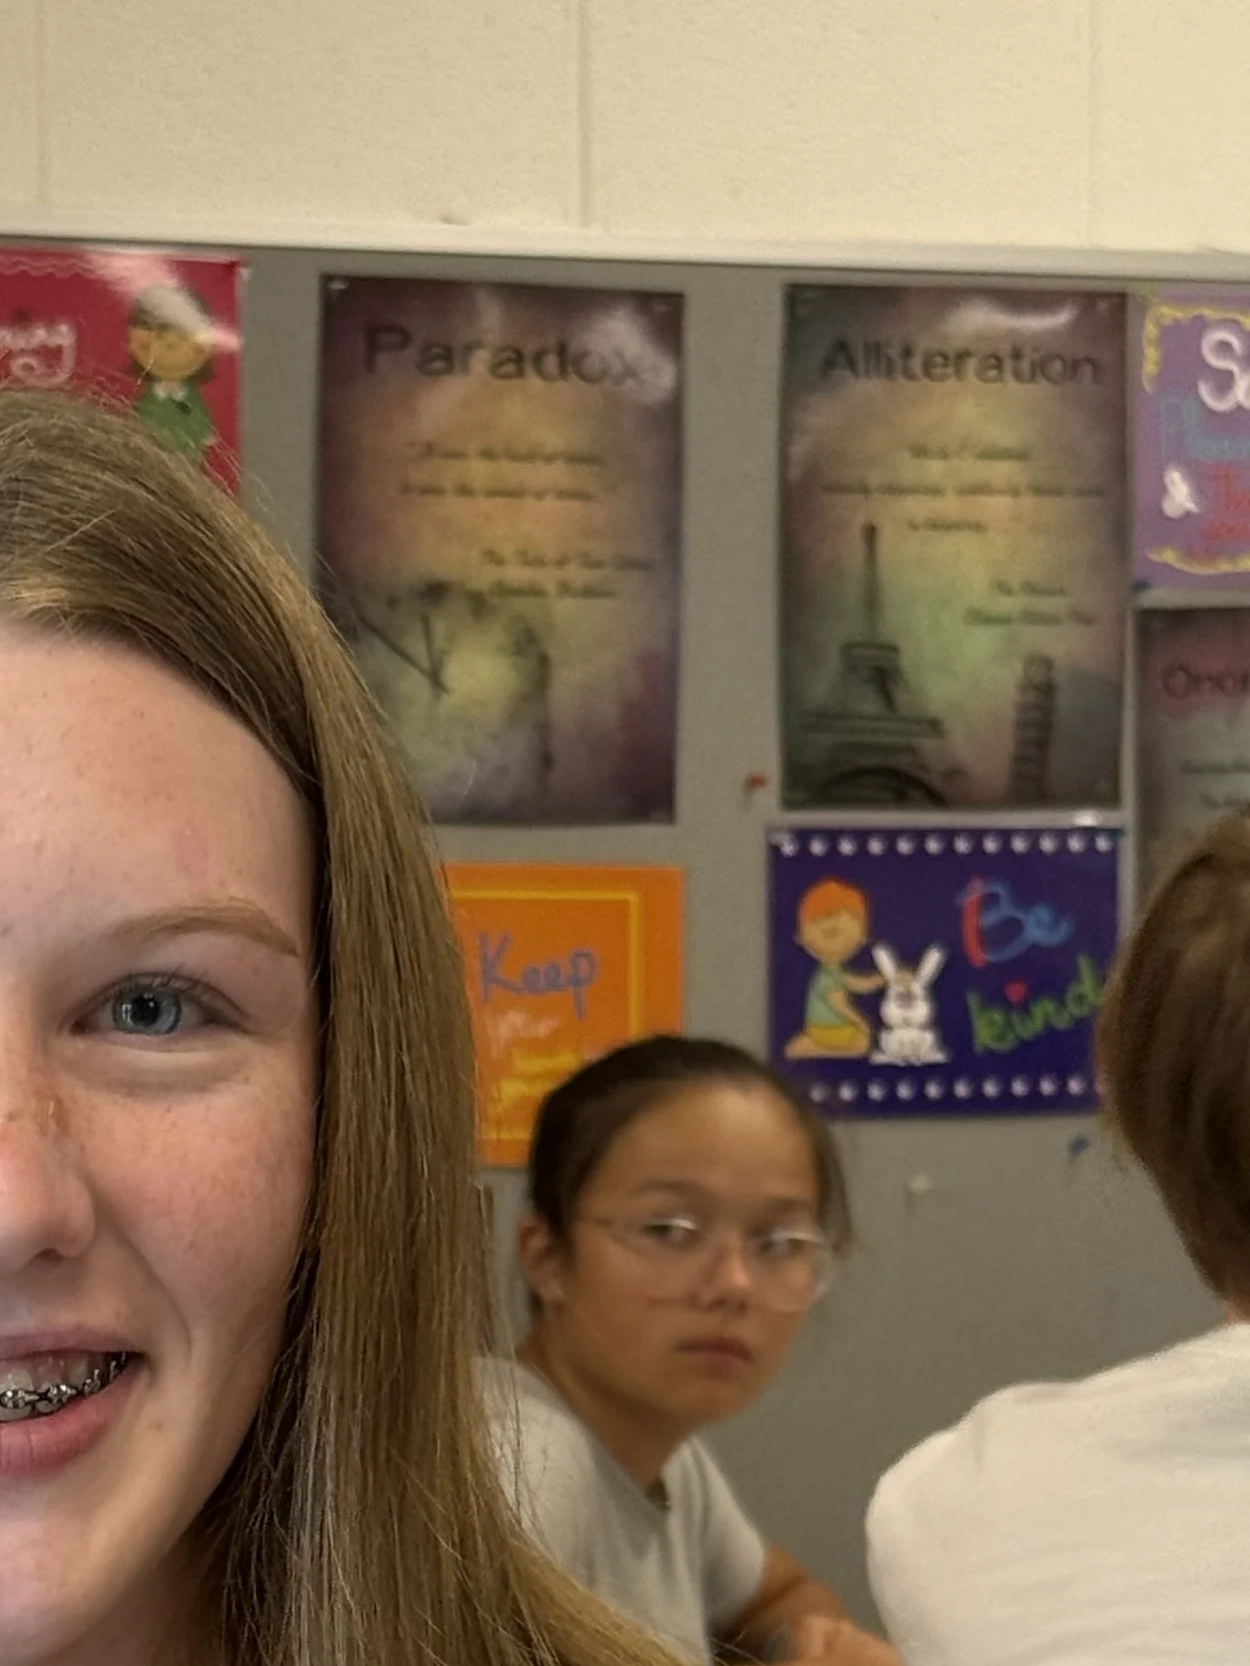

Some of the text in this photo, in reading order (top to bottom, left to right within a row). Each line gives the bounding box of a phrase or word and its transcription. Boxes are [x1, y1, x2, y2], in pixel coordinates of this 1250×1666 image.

[361, 323, 647, 384] Paradox
[819, 338, 1105, 385] Alliteration
[956, 875, 1076, 969] Be
[478, 929, 599, 1022] Keep
[966, 951, 1100, 1057] kind
